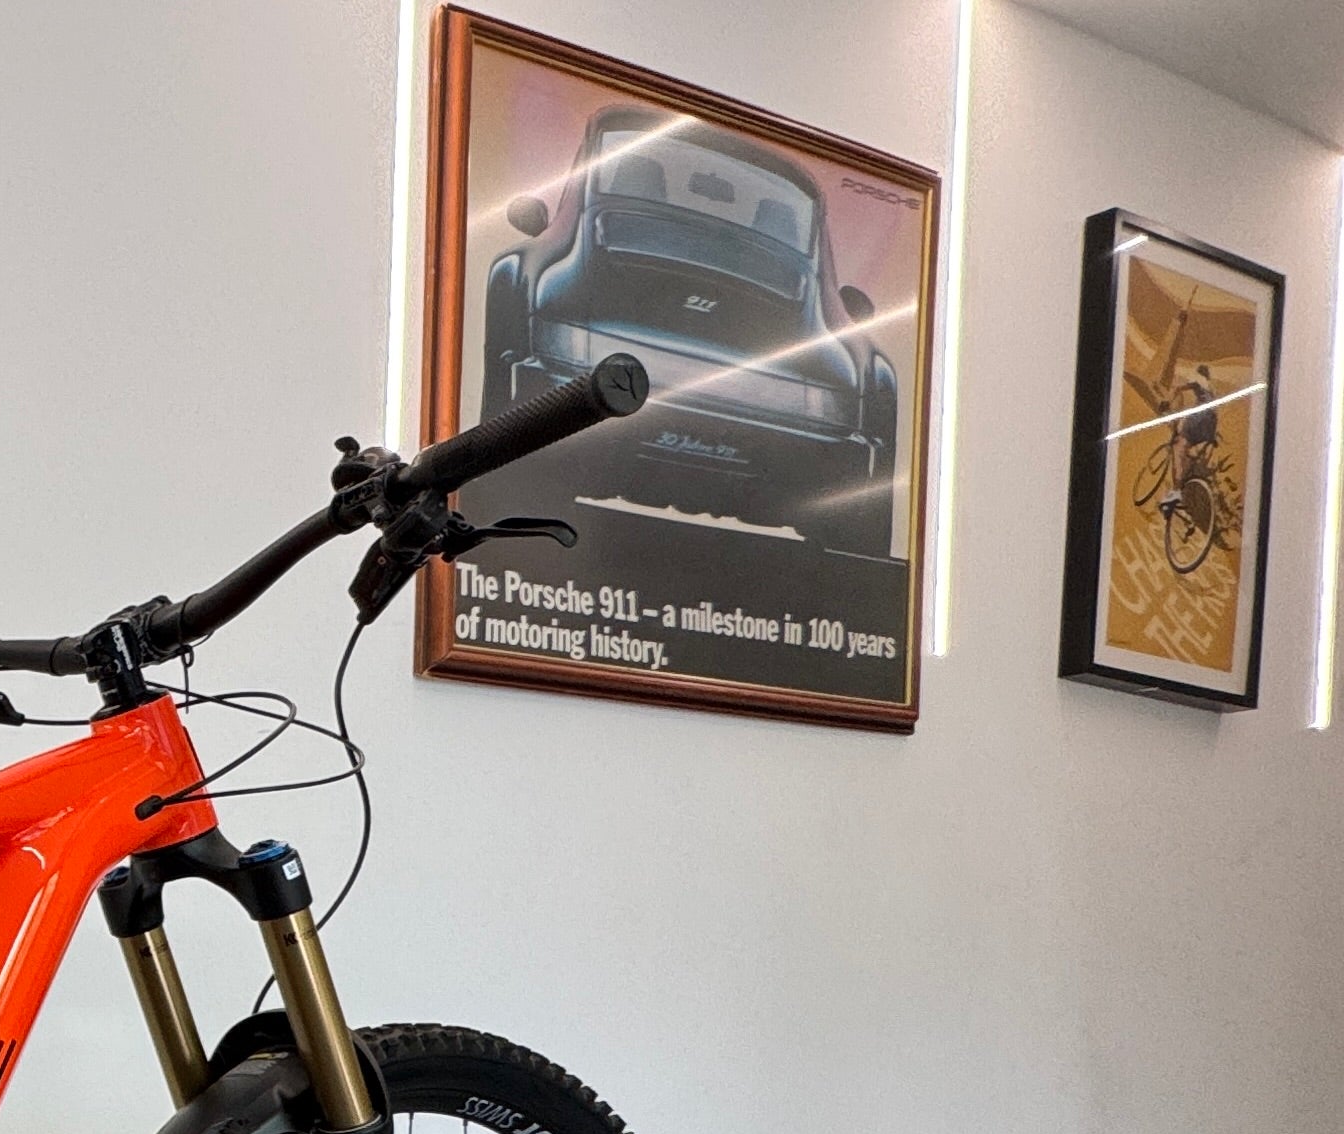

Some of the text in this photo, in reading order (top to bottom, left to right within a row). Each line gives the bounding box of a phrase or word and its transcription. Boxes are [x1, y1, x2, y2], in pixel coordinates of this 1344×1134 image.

[841, 177, 920, 210] PORSCHE
[455, 562, 499, 600] The
[504, 571, 594, 615] Porsche
[599, 589, 639, 622] 911
[662, 603, 677, 628] a
[681, 601, 778, 644] milestone
[783, 614, 802, 646] in
[808, 618, 844, 651] 100
[847, 631, 896, 659] years
[455, 607, 669, 670] of motoring history.
[456, 1096, 524, 1129] SWISS
